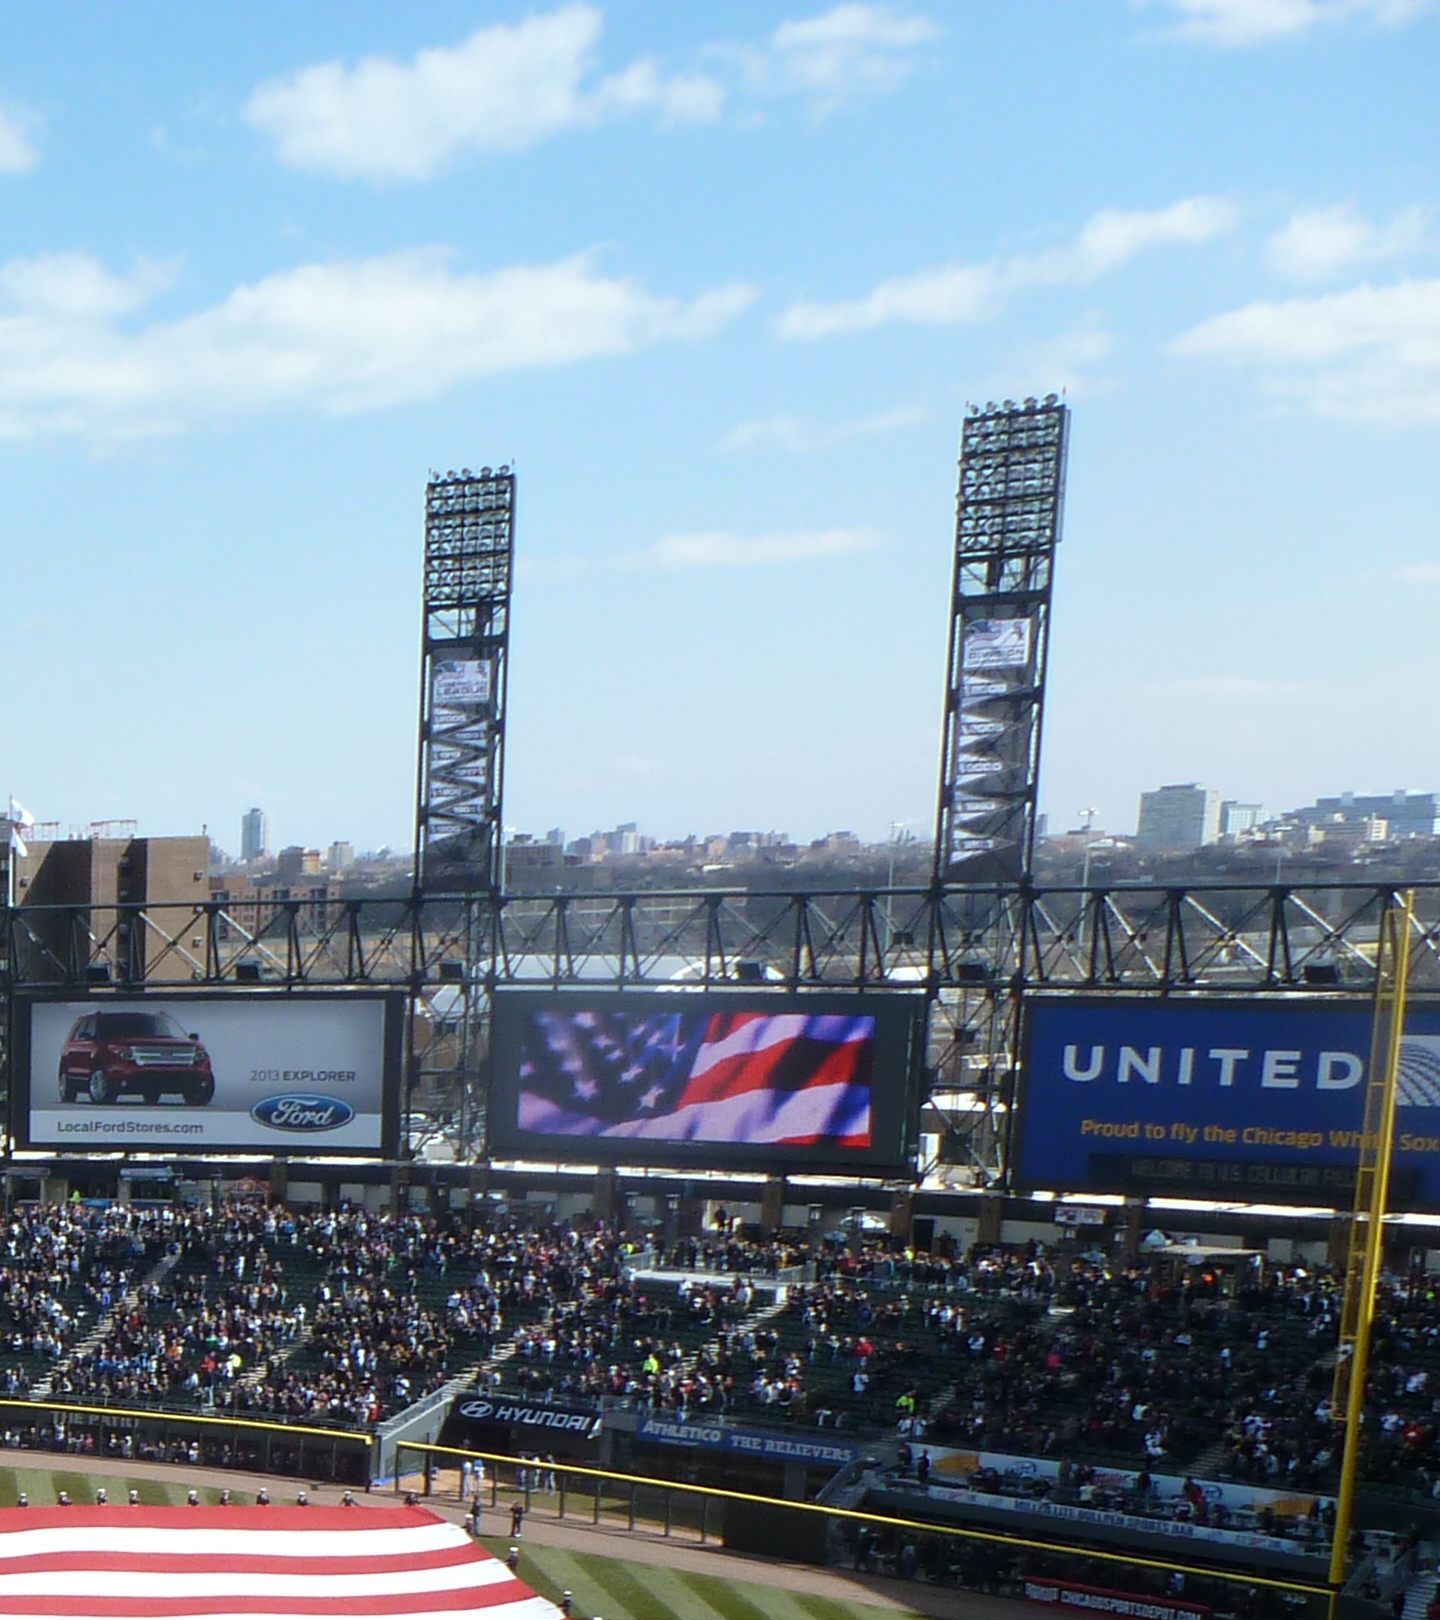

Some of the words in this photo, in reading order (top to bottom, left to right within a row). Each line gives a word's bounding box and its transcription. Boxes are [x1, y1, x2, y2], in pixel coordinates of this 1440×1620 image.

[250, 1070, 280, 1082] 2013
[283, 1070, 356, 1083] EXPLORER
[1062, 1044, 1365, 1090] UNITED
[271, 1098, 333, 1126] Ford
[57, 1121, 203, 1135] LocalFordStores.com
[1080, 1119, 1140, 1138] Proud
[1144, 1122, 1166, 1139] to
[1170, 1122, 1199, 1144] fly
[1203, 1125, 1237, 1144] the
[1241, 1126, 1324, 1151] Chicago
[1399, 1133, 1440, 1151] Sox
[494, 1404, 592, 1432] HYUNDAI
[642, 1419, 720, 1443] ATHLETICO
[730, 1434, 762, 1451] THE
[763, 1438, 852, 1463] RELIEVERS
